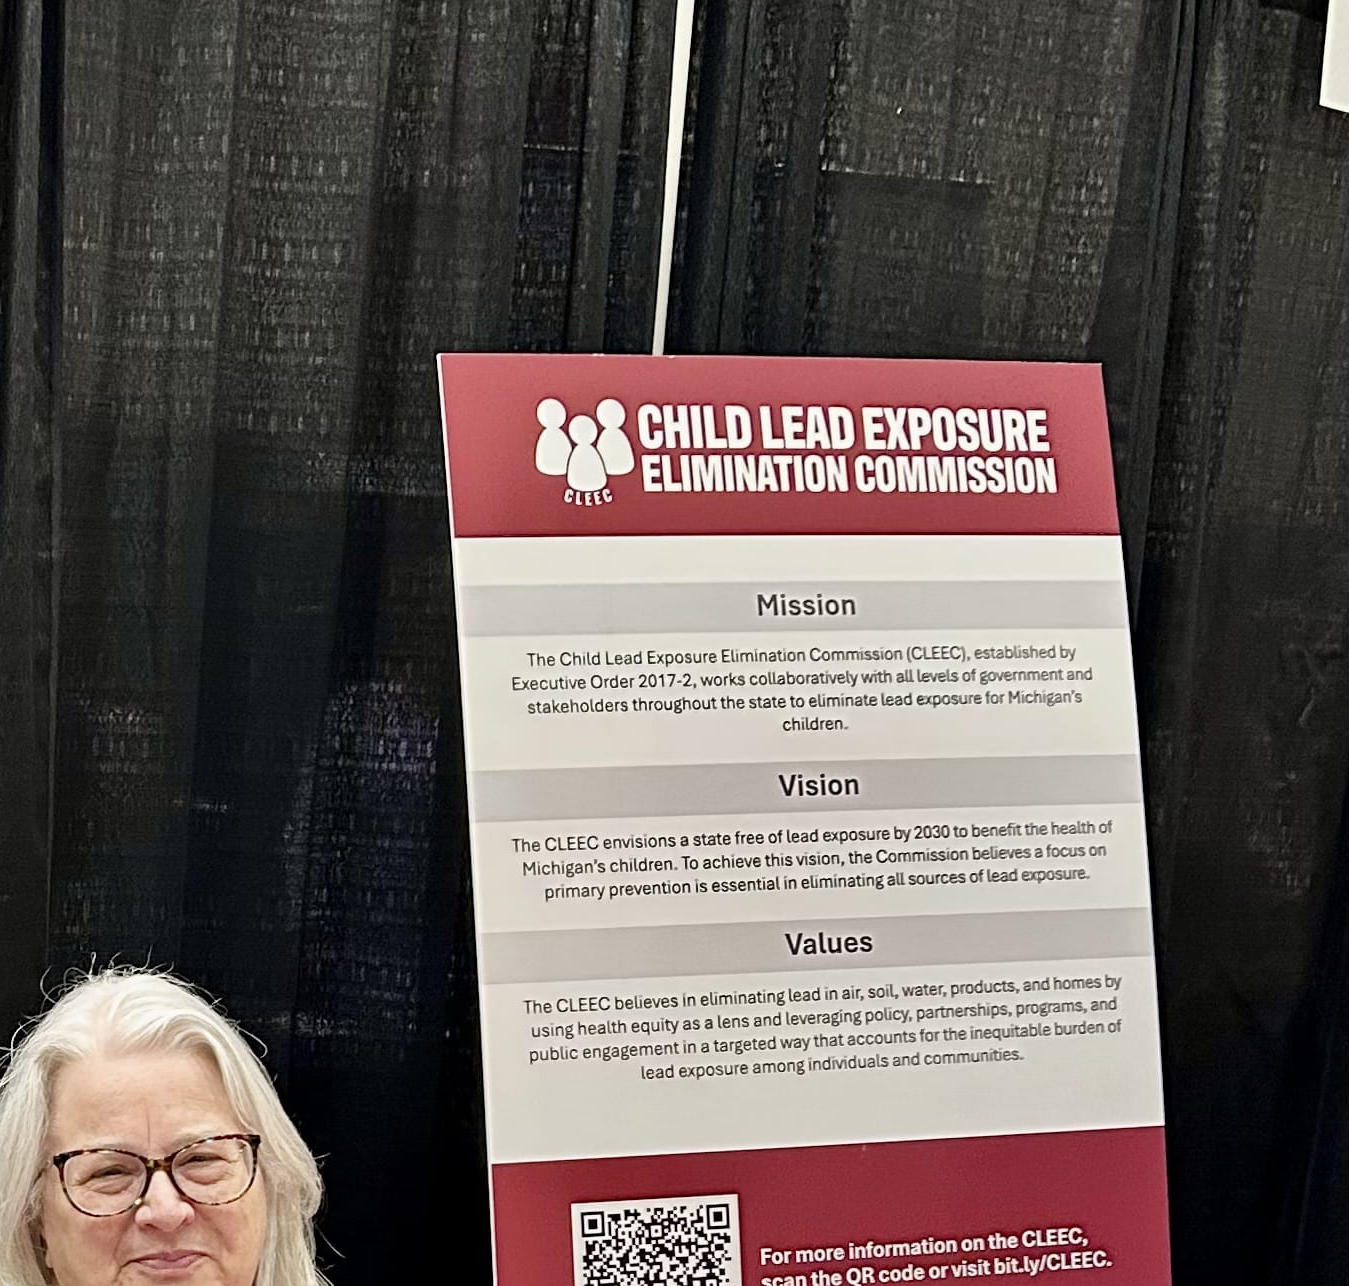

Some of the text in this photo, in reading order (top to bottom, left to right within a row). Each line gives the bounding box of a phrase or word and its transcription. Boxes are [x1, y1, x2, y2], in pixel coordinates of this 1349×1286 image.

[637, 404, 1050, 453] CHILD LEAD EXPOSURE
[641, 453, 1057, 494] ELIMINATION COMMISSION
[563, 487, 615, 507] CLEEC
[757, 594, 856, 617] Mission
[526, 645, 1076, 667] The Child Lead Exposure Elimination Commission (CLEEC), established by
[512, 667, 1092, 691] Executive Order 2017-2, works collaboratively with all levels of government and
[528, 690, 1082, 714] stakeholders throughout the state to eliminate lead exposure for Michigan’s
[783, 717, 849, 731] children.
[778, 773, 860, 796] Vision
[512, 820, 1112, 852] The CLEEC envisions a state free of lead exposure by 2030 to benefit the health of
[522, 844, 1106, 878] Michigan’s children. To achieve this vision, the Commission believes a focus on
[545, 868, 1091, 902] primary prevention is essential in eliminating all sources of lead exposure.
[785, 931, 873, 955] Values
[524, 974, 1122, 1014] The CLEEC believes in eliminating lead in air, soil, water, products, and homes by
[532, 997, 1117, 1040] using health equity as a lens and leveraging policy, partnerships, programs, and
[530, 1019, 1122, 1064] public engagement in a targeted way that accounts for the inequitable burden of
[641, 1049, 1024, 1080] lead exposure among individuals and communities.
[761, 1227, 1089, 1265] For more information on the CLEEC,
[878, 1263, 925, 1283] code
[929, 1263, 949, 1279] or
[952, 1259, 991, 1278] visit
[994, 1250, 1113, 1276] bit.ly/CLEEC.
